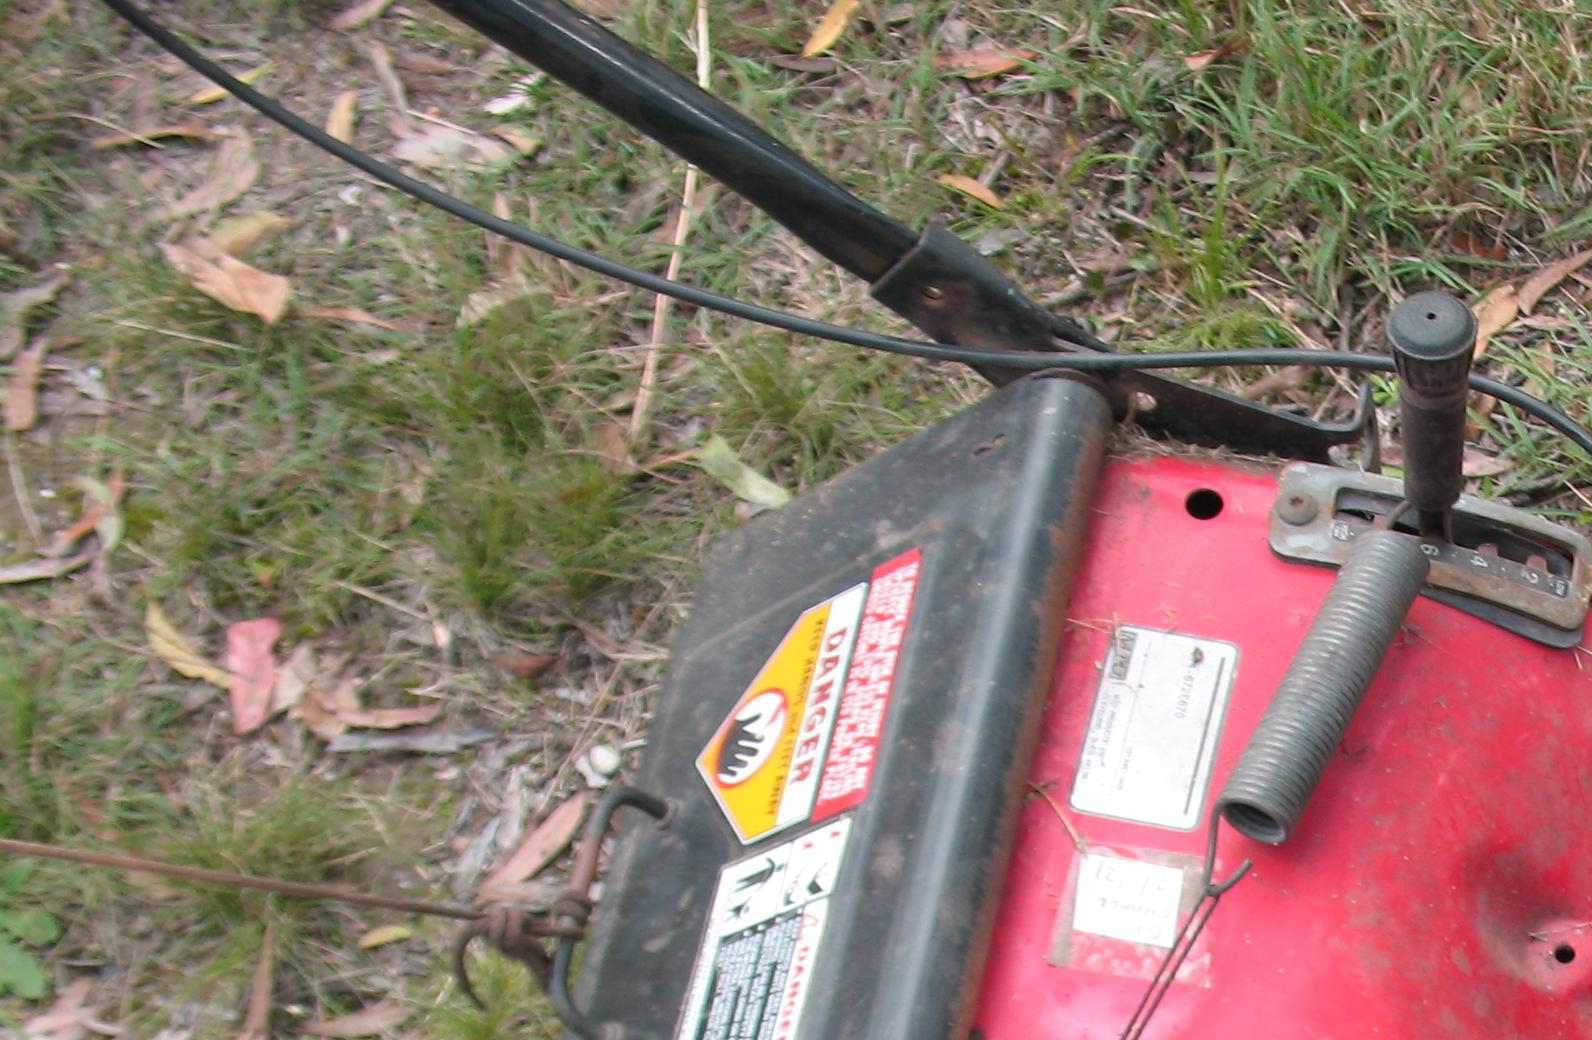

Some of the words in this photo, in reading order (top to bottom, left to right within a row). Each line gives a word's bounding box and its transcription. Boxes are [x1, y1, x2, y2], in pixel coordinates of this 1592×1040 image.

[1470, 555, 1488, 568] 4
[1520, 568, 1539, 584] 2
[789, 625, 849, 786] DANGER
